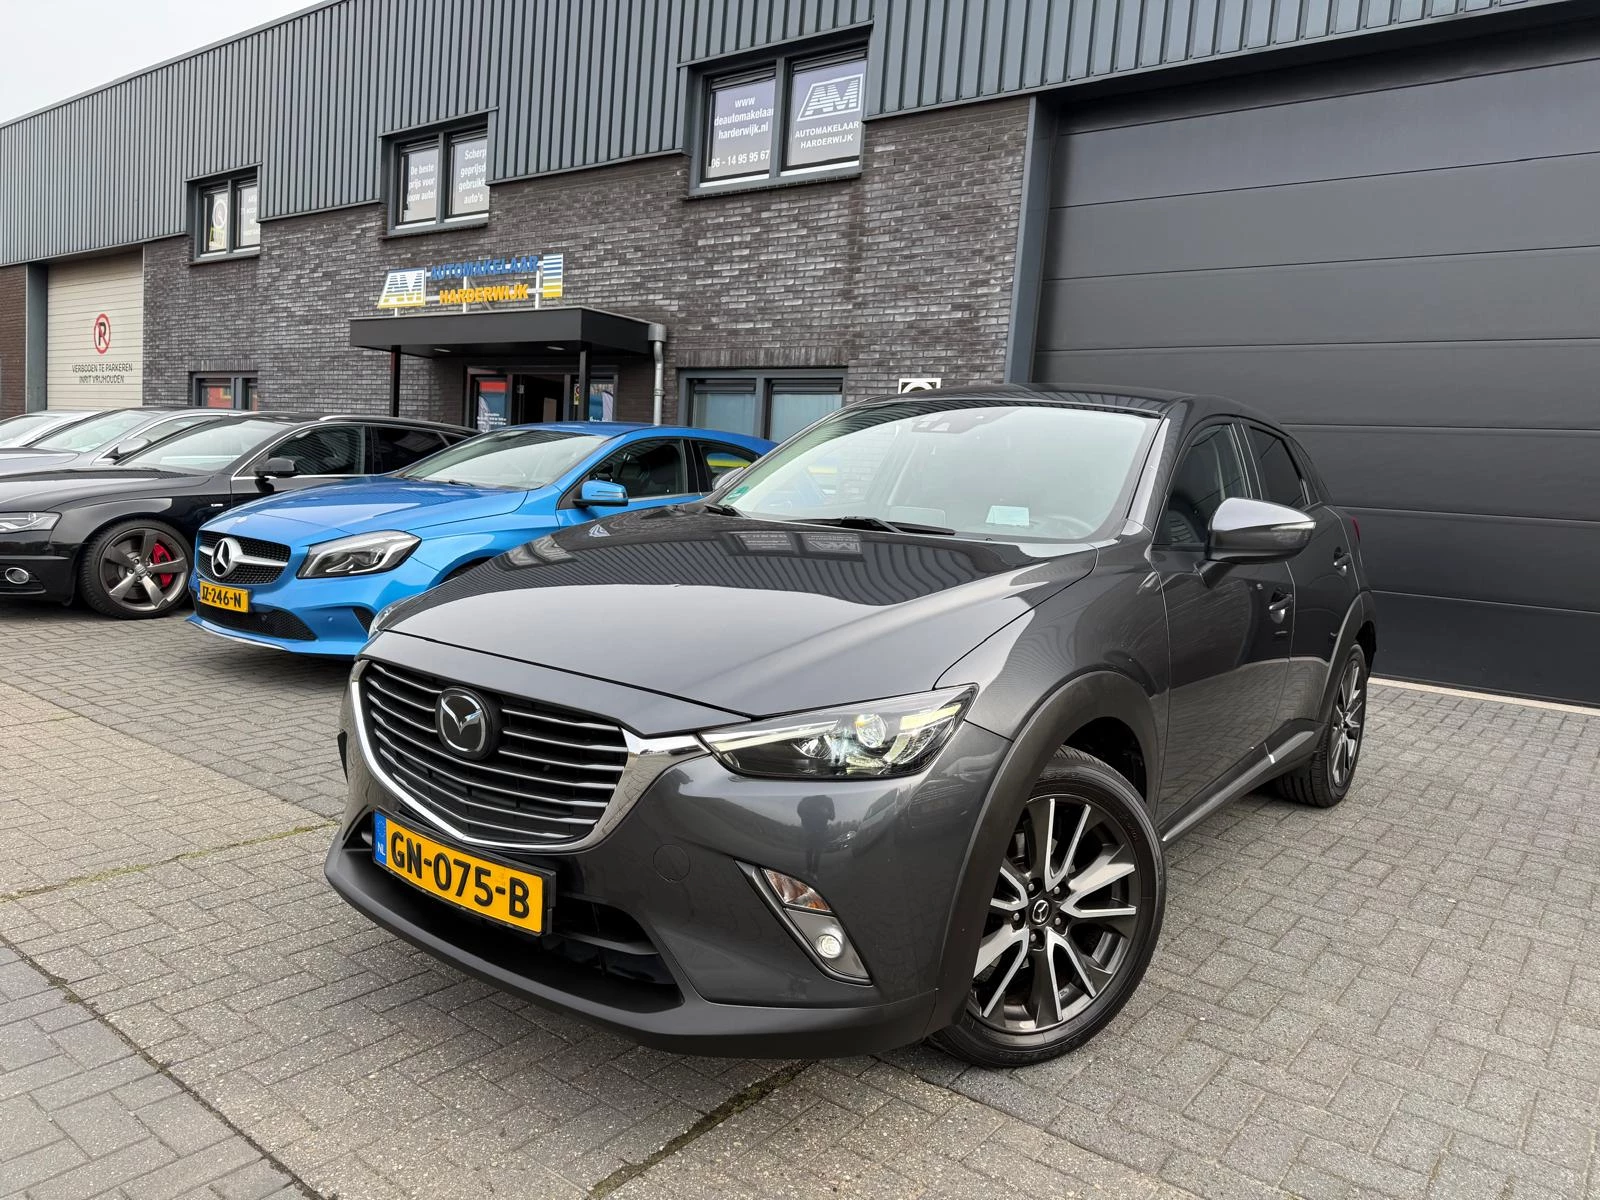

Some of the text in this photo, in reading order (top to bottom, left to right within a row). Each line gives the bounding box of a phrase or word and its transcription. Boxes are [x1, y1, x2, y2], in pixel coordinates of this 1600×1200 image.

[735, 96, 756, 108] www
[718, 121, 769, 139] harderwijk.nl
[795, 120, 859, 138] AUTOMAKELAAR
[800, 133, 854, 149] HARDERWIJK
[727, 155, 737, 166] 14
[738, 153, 748, 164] 95
[749, 151, 759, 162] 95
[760, 150, 770, 161] 67
[463, 193, 484, 204] auto's
[430, 255, 539, 280] AUTOMAKELAAR
[439, 284, 529, 304] HARDERWIJK
[72, 363, 133, 373] VERBODEN TE PARKEREN
[377, 841, 386, 856] NL
[390, 831, 530, 919] GN-075-B
